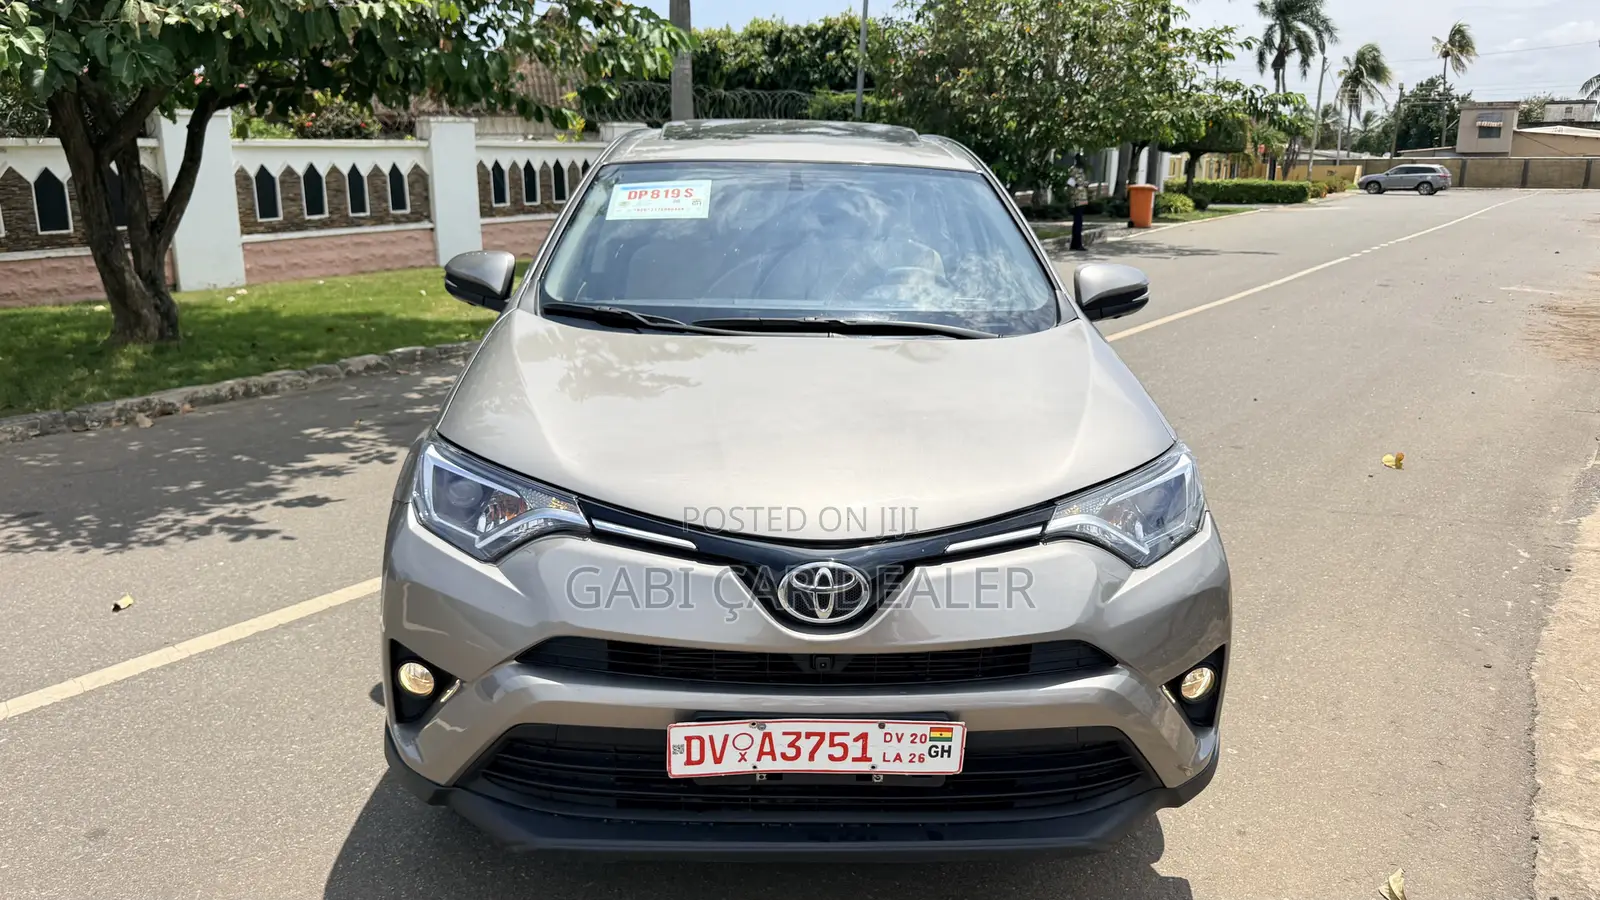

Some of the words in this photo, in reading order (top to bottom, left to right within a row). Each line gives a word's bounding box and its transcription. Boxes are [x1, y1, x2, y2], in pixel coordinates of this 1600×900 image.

[883, 732, 904, 743] DV
[910, 733, 927, 744] 20
[684, 734, 729, 766] DV
[756, 731, 872, 762] A3751
[928, 745, 951, 759] GH
[882, 752, 903, 763] LA
[908, 753, 926, 763] 26
